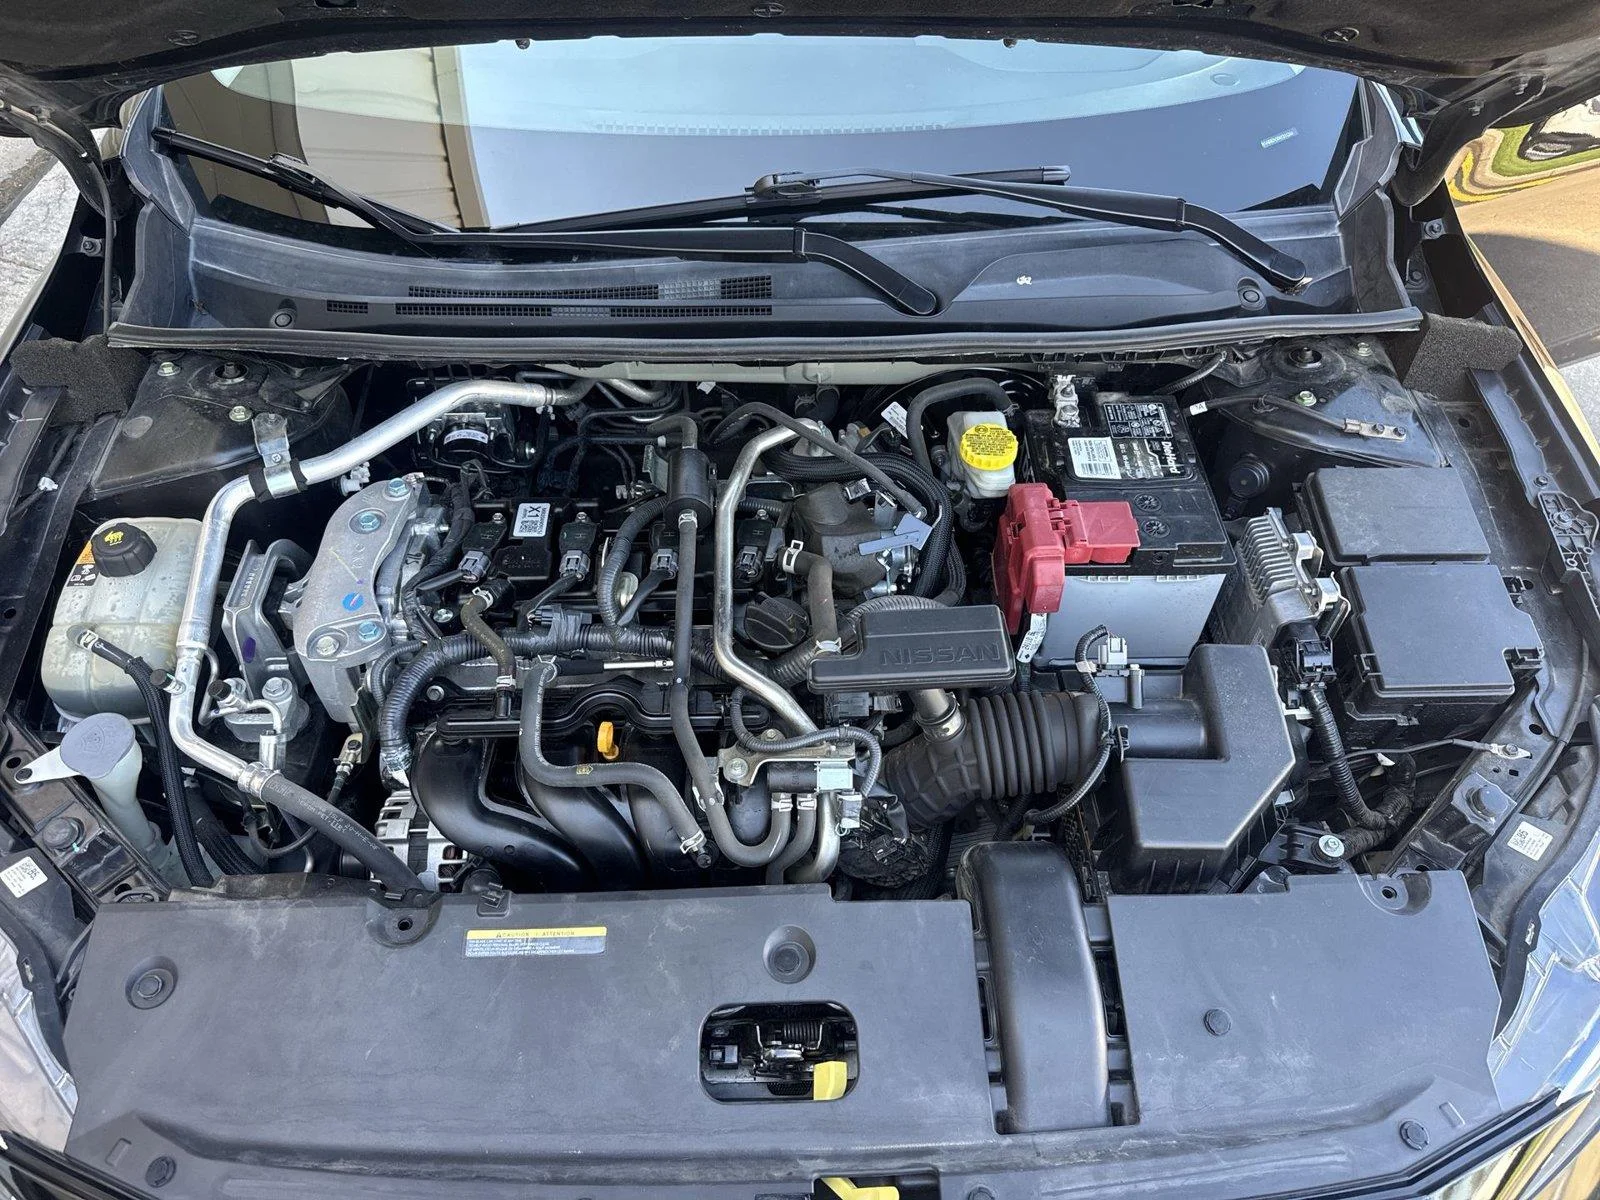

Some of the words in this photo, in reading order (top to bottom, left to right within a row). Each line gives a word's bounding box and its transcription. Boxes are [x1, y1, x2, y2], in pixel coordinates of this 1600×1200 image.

[1161, 441, 1181, 474] DieHard
[528, 505, 541, 518] X1
[881, 642, 1001, 666] NISSAN
